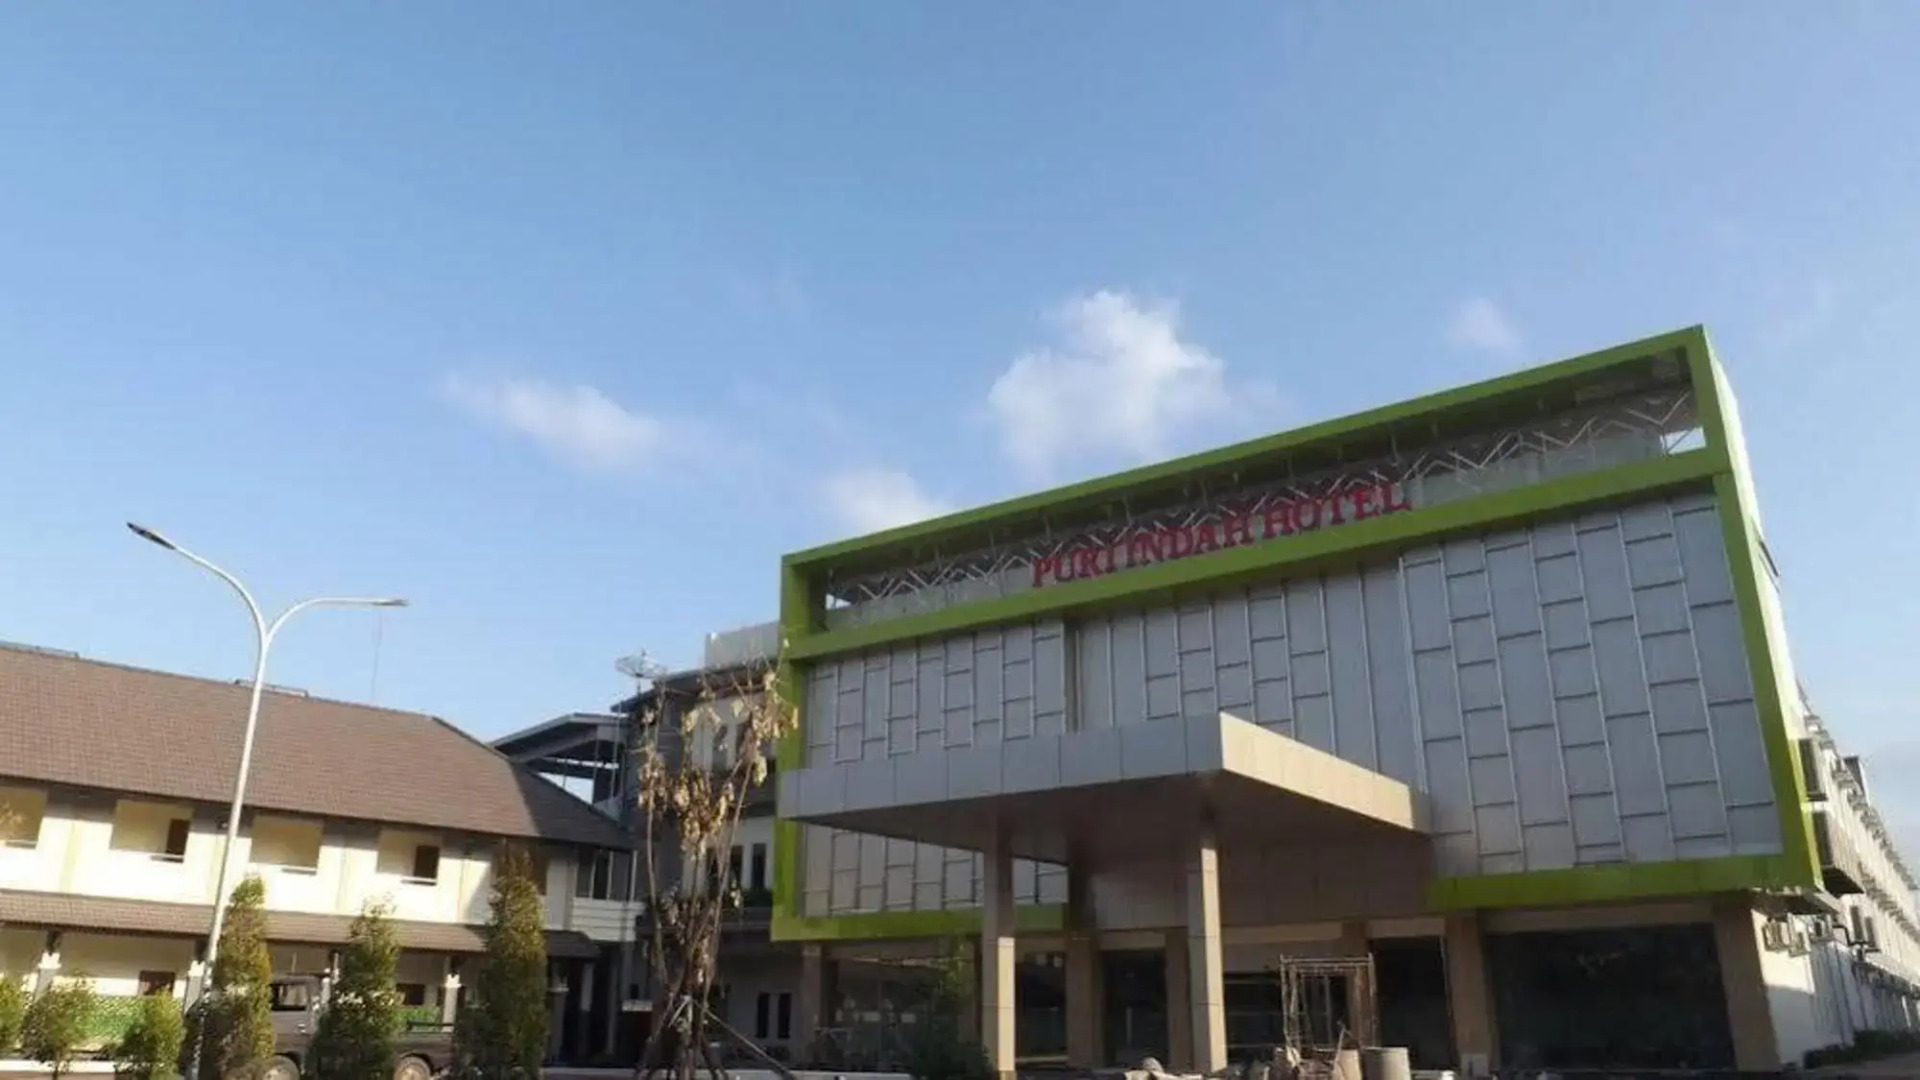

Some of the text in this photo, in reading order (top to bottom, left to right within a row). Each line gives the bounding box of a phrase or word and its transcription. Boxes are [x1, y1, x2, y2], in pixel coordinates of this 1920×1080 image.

[1031, 481, 1412, 587] PURI INDAH HOTEL
